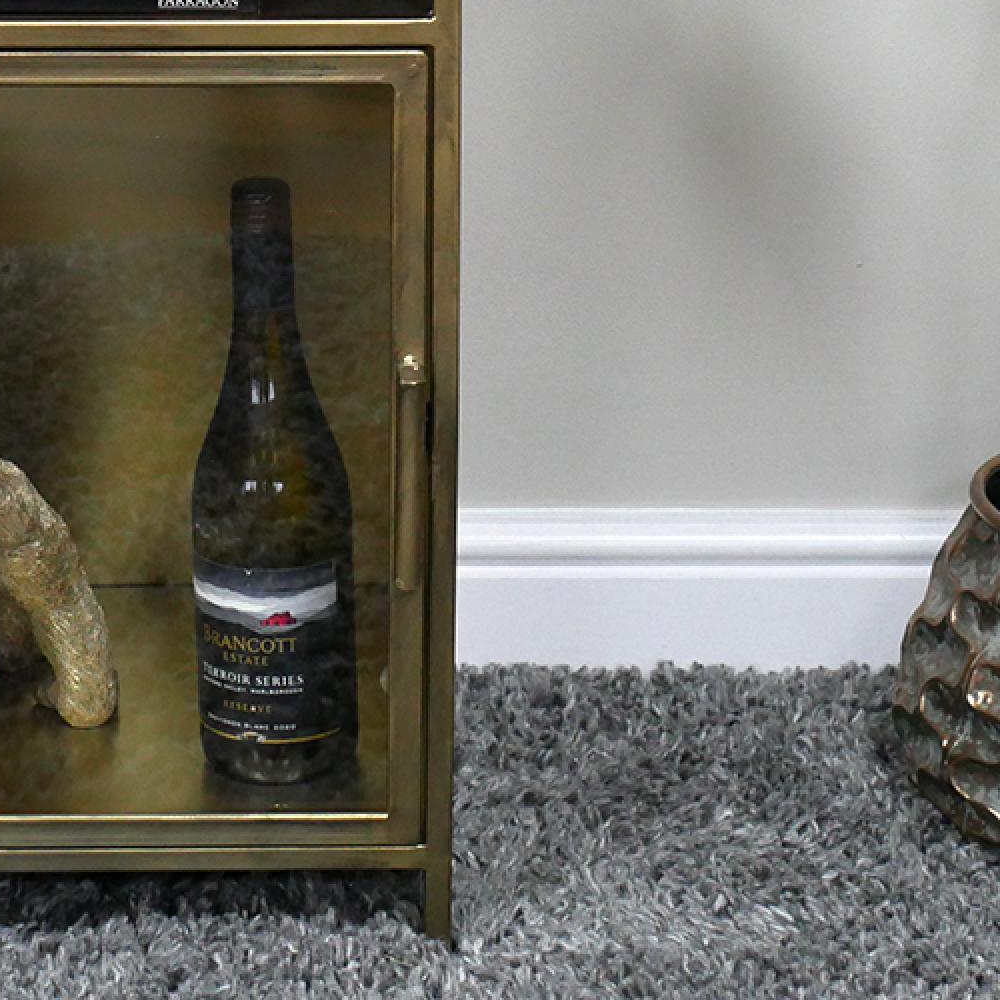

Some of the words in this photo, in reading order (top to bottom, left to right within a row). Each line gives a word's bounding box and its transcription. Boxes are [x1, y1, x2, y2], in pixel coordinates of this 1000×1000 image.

[203, 623, 297, 653] BRANCOTT
[223, 651, 269, 666] ESTATE
[255, 674, 305, 687] SERIES
